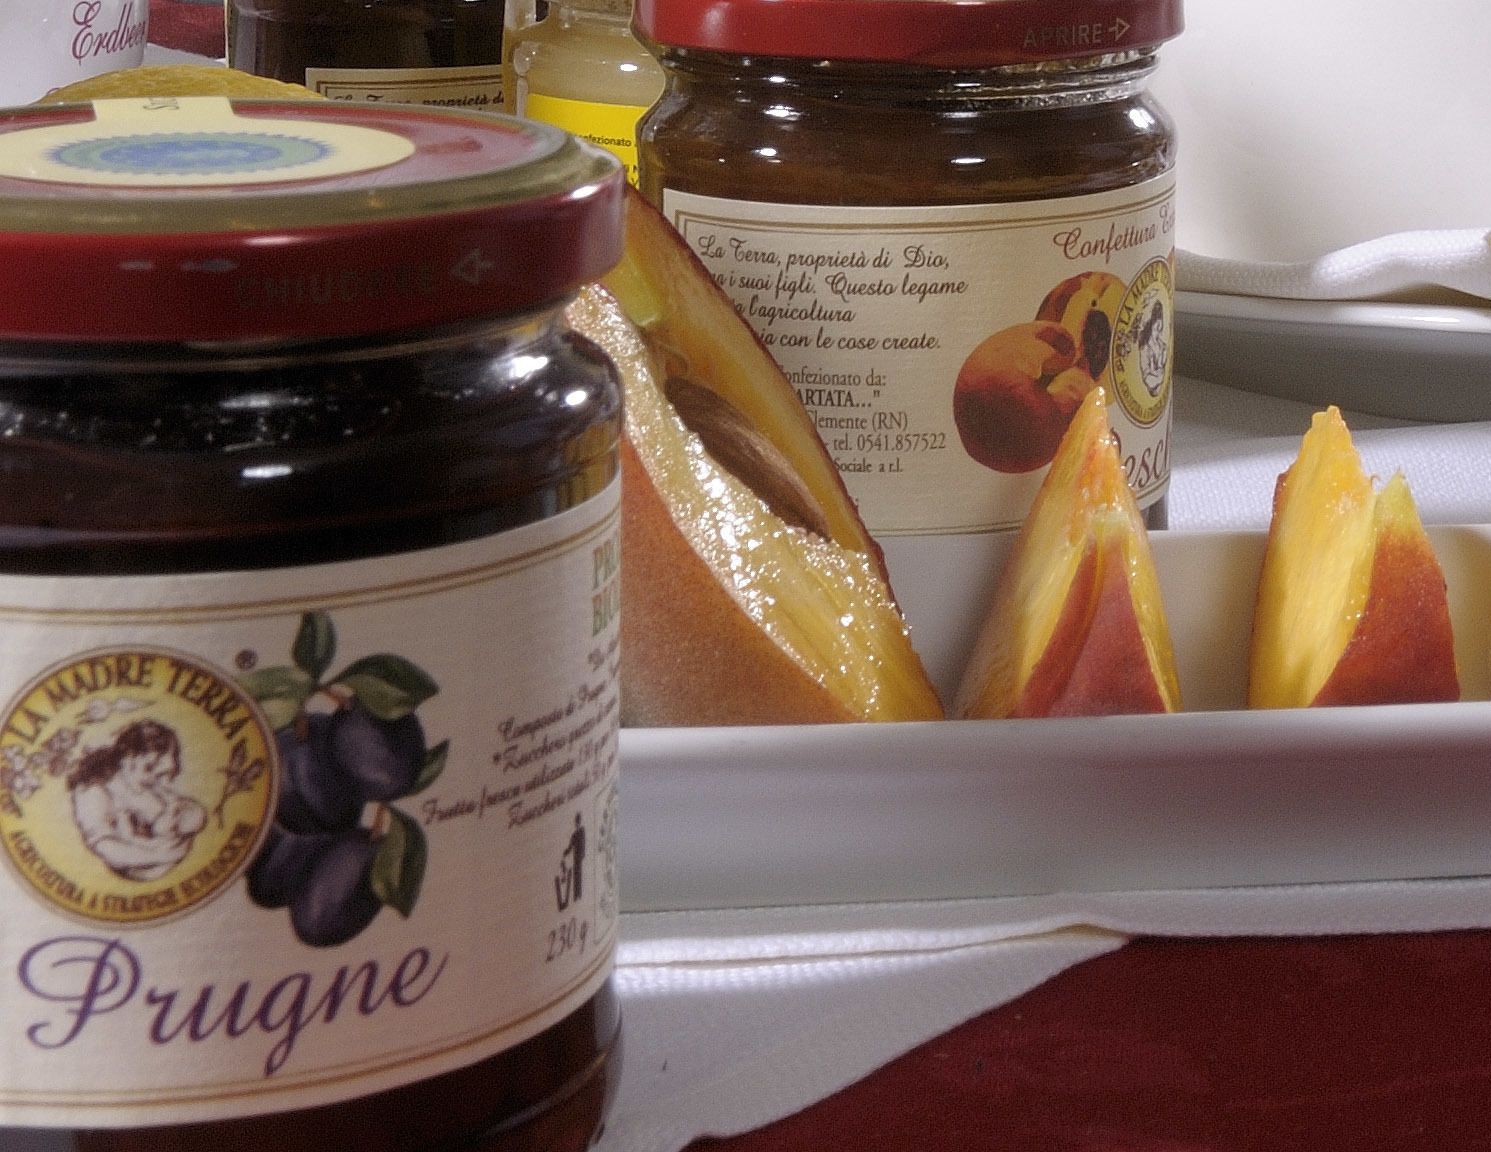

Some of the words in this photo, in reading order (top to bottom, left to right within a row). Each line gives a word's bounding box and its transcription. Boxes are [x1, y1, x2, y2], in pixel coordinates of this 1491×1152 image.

[1023, 23, 1102, 47] APRIRE
[698, 235, 726, 259] La
[729, 238, 781, 265] Terra,
[786, 250, 868, 274] proprietà
[872, 248, 891, 268] di
[903, 244, 949, 270] Dio,
[1053, 222, 1158, 264] Confettura
[729, 271, 736, 287] i
[739, 275, 772, 290] suoi
[775, 269, 816, 300] figli.
[826, 271, 897, 302] Questo
[902, 272, 969, 303] legame
[780, 333, 812, 347] con
[816, 326, 833, 349] le
[838, 334, 878, 350] cose
[882, 330, 941, 350] create.
[785, 366, 861, 386] onfezionato
[866, 368, 886, 386] da:
[796, 389, 881, 408] ARTATA..."
[872, 411, 908, 432] (RN)
[833, 433, 850, 450] tel.
[857, 433, 946, 452] 0541.857522
[834, 457, 872, 473] Sociale
[8, 708, 50, 742] LA
[46, 654, 153, 711] MADRE
[167, 658, 251, 741] TERRA
[18, 935, 448, 1077] Prugne
